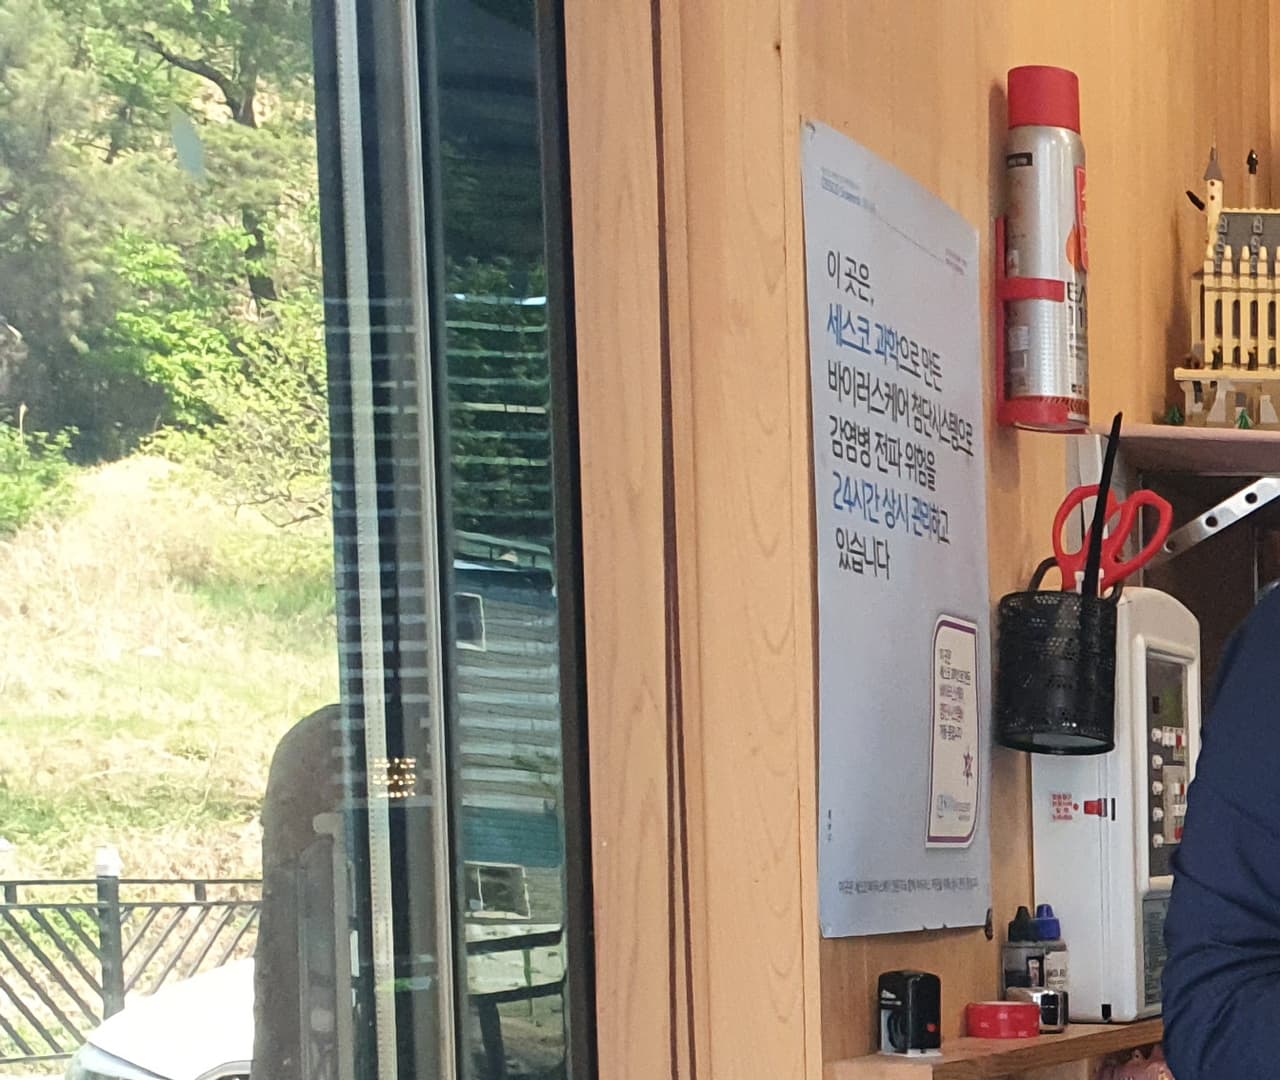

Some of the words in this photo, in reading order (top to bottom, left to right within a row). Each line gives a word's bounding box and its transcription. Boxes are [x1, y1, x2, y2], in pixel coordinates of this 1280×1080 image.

[827, 250, 841, 289] 이
[845, 256, 874, 306] 곳은,
[827, 303, 872, 355] 세스코
[874, 323, 922, 379] 과학으로
[922, 347, 943, 393] 만든
[828, 360, 910, 428] 바이러스케어
[829, 415, 872, 468] 감염병
[874, 431, 903, 479] 전파
[904, 442, 936, 492] 위험을
[832, 471, 880, 525] 24시간
[882, 488, 910, 533] 상시
[911, 493, 951, 545] 관리하고
[835, 527, 891, 581] 있습니다
